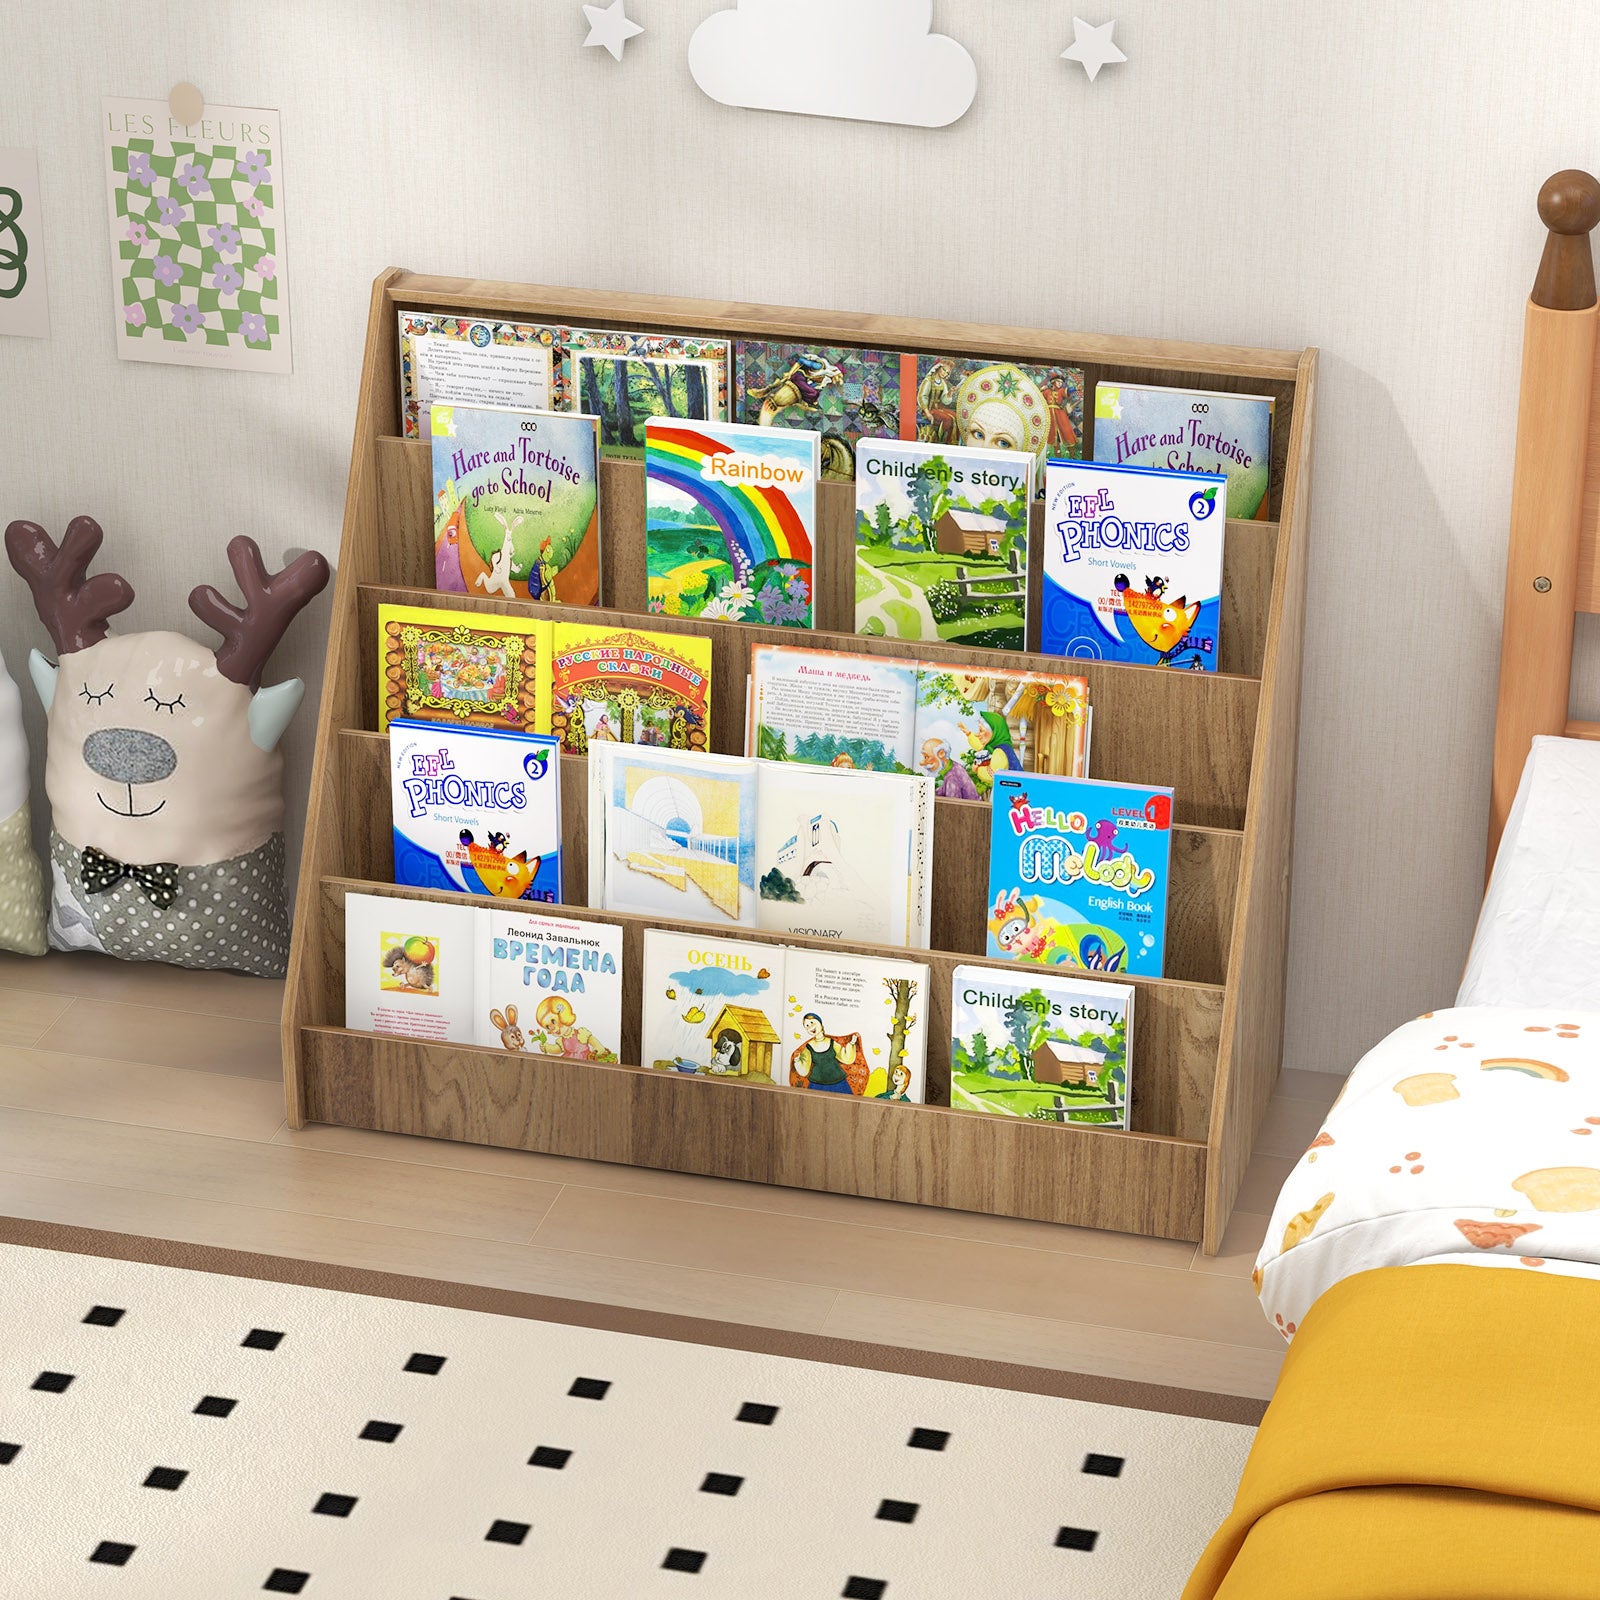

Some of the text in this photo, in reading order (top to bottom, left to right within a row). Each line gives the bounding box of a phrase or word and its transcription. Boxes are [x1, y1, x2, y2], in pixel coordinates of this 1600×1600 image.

[108, 112, 270, 144] LES FLEURS
[1115, 419, 1252, 469] Hare and Tortoise
[452, 436, 581, 485] Hare and Tortoise
[711, 457, 804, 483] Rainbow
[472, 467, 552, 507] go to School
[866, 459, 1020, 491] Children's story
[1068, 488, 1115, 519] EFL
[1197, 501, 1205, 515] 2
[1057, 515, 1191, 563] PHONICS
[1088, 557, 1137, 570] Short Vowels
[557, 648, 702, 686] РУССКИЕ НАРОДНЫЕ
[598, 662, 662, 680] СКАЗКИ
[412, 749, 455, 777] EFL
[531, 762, 539, 775] 2
[403, 774, 528, 818] PHONICS
[433, 812, 480, 826] Short Vowels
[1010, 806, 1086, 834] HELLO
[1112, 805, 1156, 819] LEVEL 1
[1088, 896, 1153, 913] English Book
[507, 927, 600, 948] Леонид Завальнюк
[493, 937, 616, 975] ВРЕМЕНА
[687, 949, 753, 972] ОСЕНЬ
[523, 965, 586, 994] ГОДА
[963, 989, 1119, 1026] Children's story
